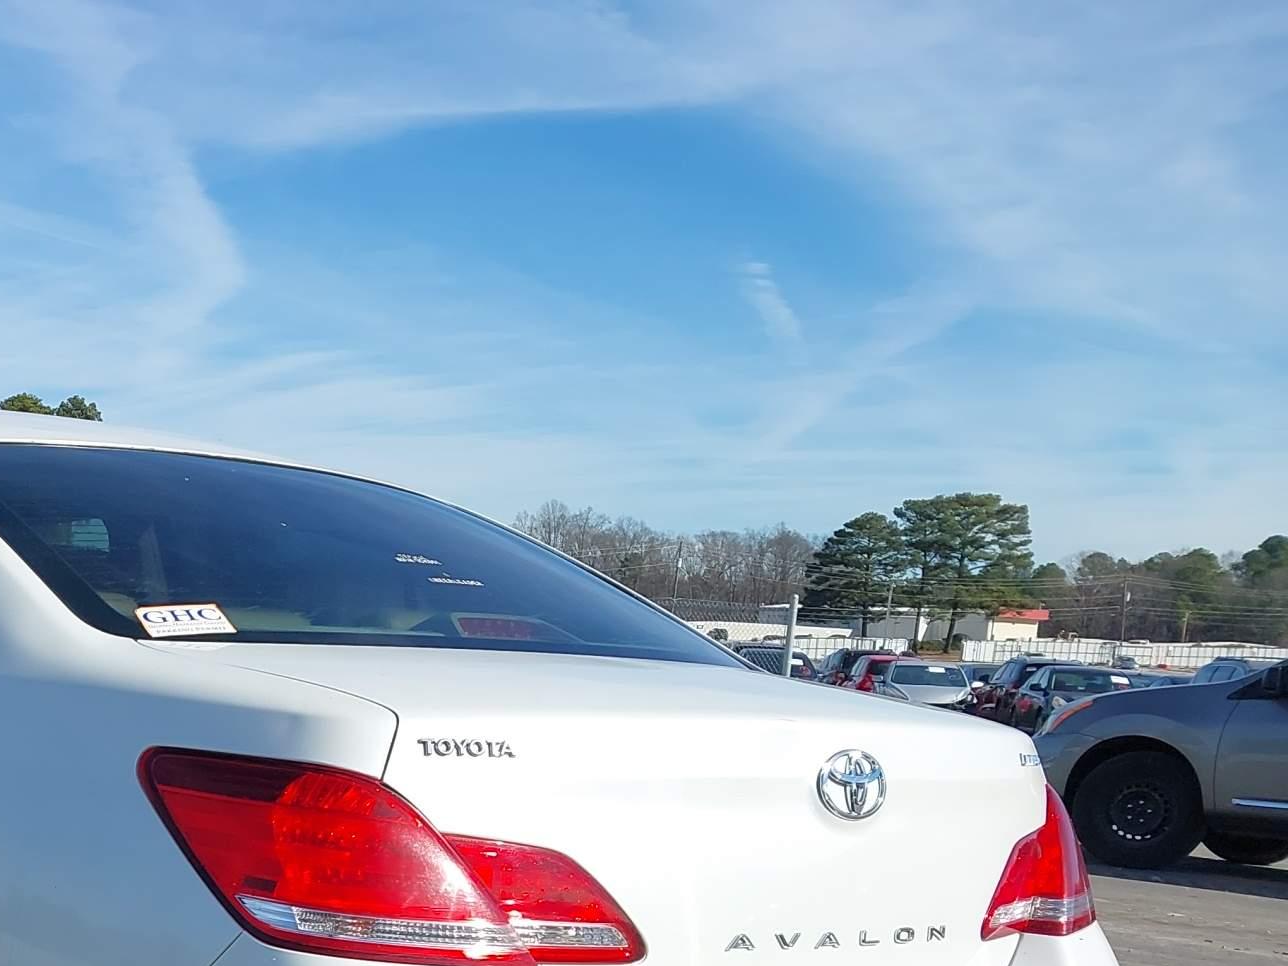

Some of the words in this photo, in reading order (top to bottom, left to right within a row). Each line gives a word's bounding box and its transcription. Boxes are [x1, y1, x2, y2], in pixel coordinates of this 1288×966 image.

[142, 608, 222, 624] GHC
[416, 738, 517, 758] TOYOTA
[724, 925, 947, 952] AVALON
